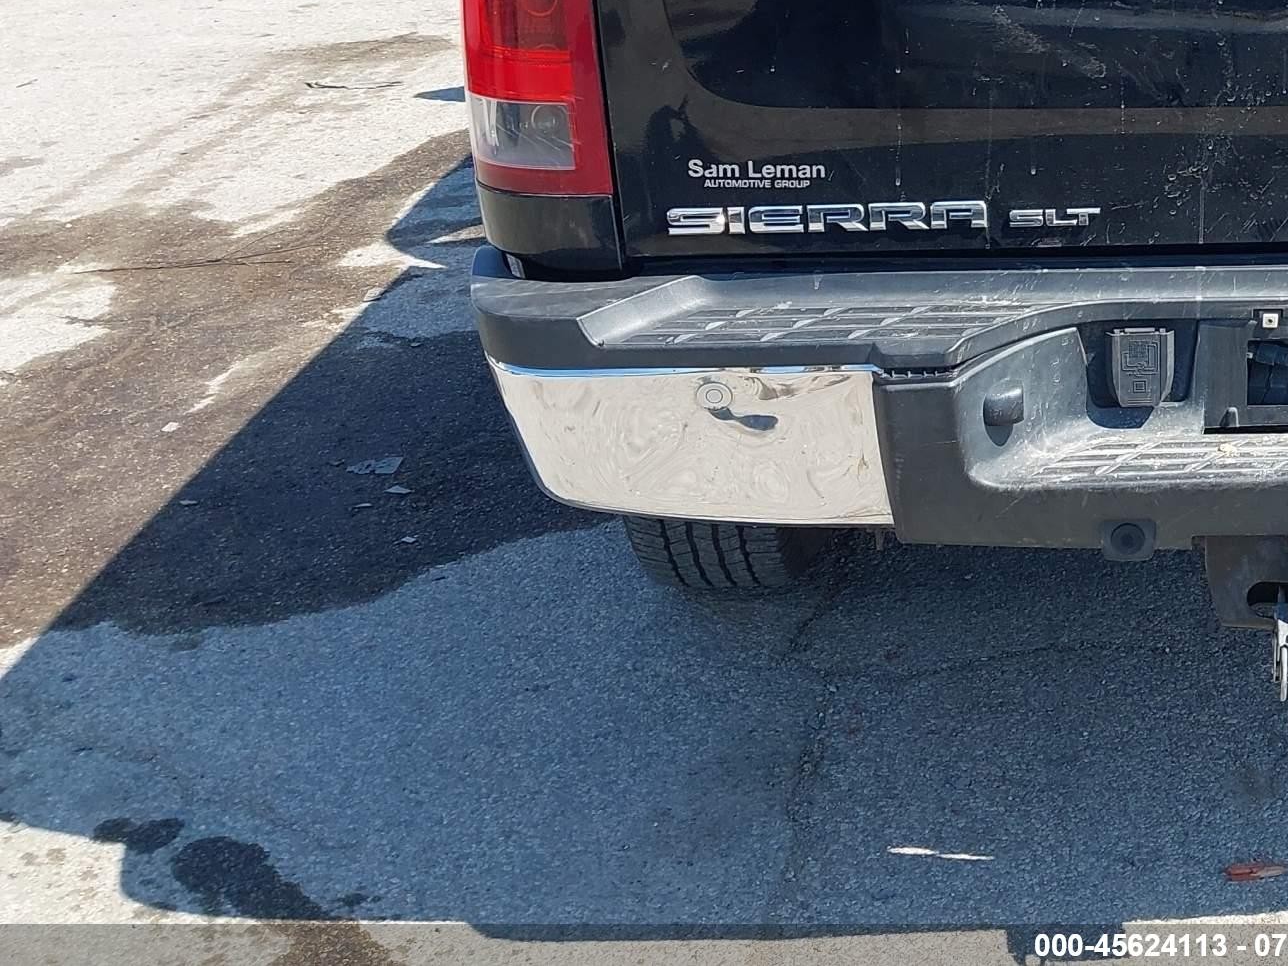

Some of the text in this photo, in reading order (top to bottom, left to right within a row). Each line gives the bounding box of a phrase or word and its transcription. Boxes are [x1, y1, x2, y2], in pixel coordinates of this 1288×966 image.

[688, 159, 826, 178] Sam Leman
[704, 179, 811, 188] AUTOMOTIVE GROUP
[667, 200, 1101, 235] SIERRA SLT
